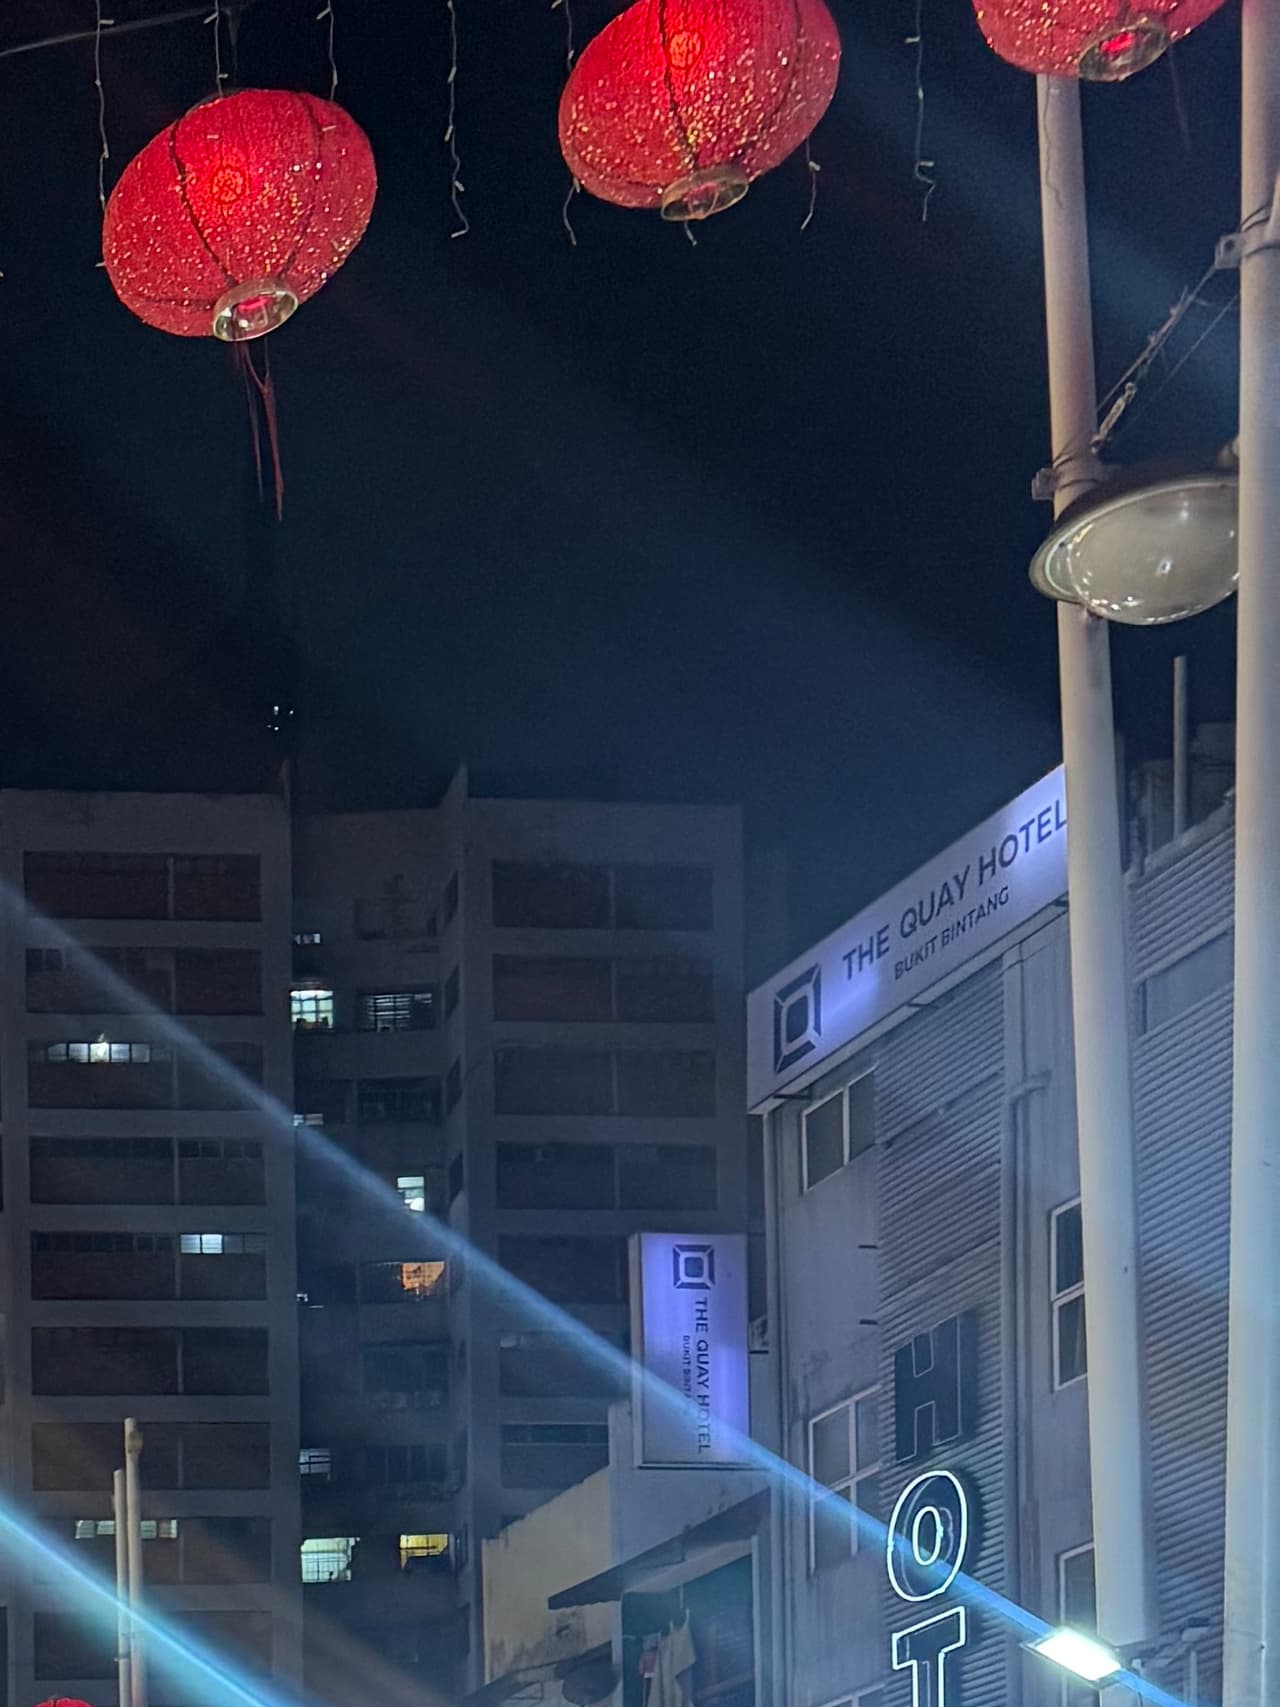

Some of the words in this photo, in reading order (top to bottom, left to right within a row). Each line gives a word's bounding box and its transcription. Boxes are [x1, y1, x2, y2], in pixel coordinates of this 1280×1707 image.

[842, 925, 890, 980] THE
[899, 865, 970, 937] QUAY
[978, 800, 1067, 886] HOTEL
[894, 935, 937, 980] BUKIT
[942, 886, 1010, 946] BINTANG
[695, 1297, 708, 1333] THE
[696, 1340, 709, 1389] QUAY
[697, 1395, 711, 1454] HOTEL
